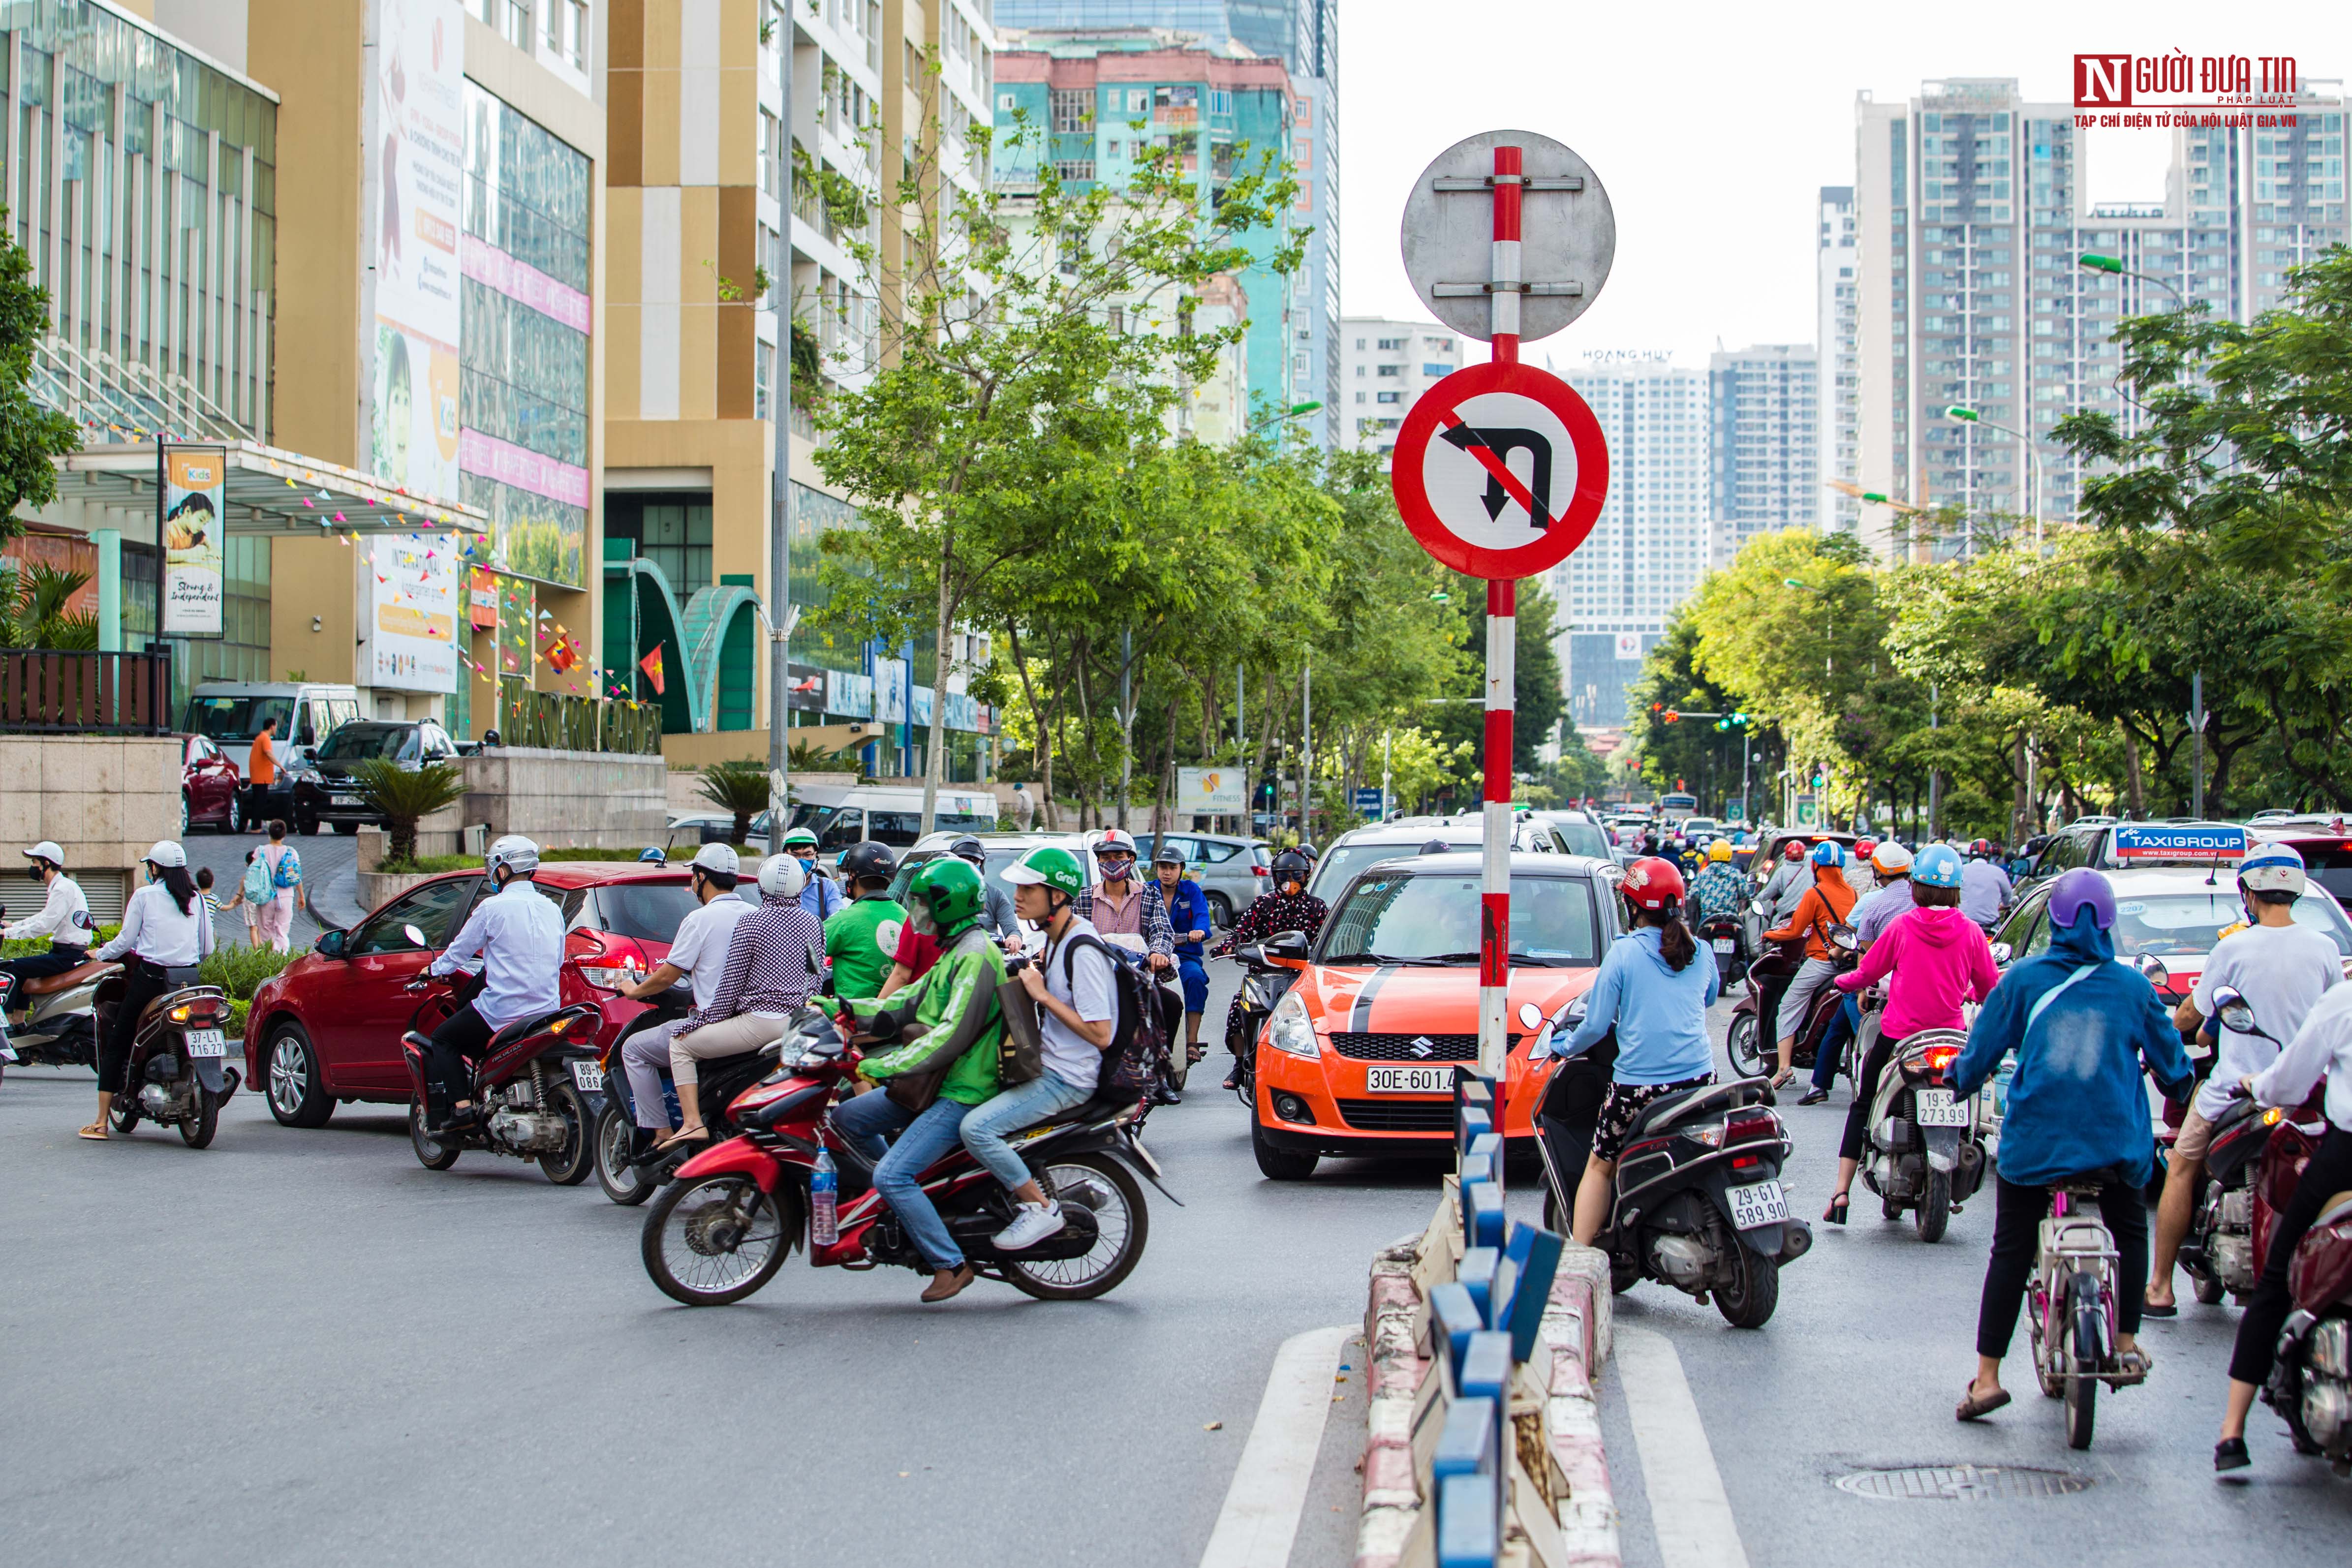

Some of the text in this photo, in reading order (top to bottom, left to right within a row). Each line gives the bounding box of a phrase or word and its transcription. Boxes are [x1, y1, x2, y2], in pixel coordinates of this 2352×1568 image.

[1643, 350, 1673, 360] HUY
[188, 469, 210, 480] Kids
[178, 581, 214, 594] Strong &
[171, 591, 219, 603] Independent
[2131, 836, 2241, 848] TAXIGROUP
[1055, 871, 1078, 887] Grab
[191, 1032, 217, 1043] 37-L1
[190, 1044, 222, 1055] 716.27
[579, 1077, 599, 1088] 086
[1371, 1070, 1455, 1089] 30E-601.4
[1926, 1093, 1958, 1107] 19-S
[1921, 1108, 1964, 1122] 273.99
[1734, 1183, 1775, 1206] 29-G1
[1735, 1202, 1786, 1225] 589.90
